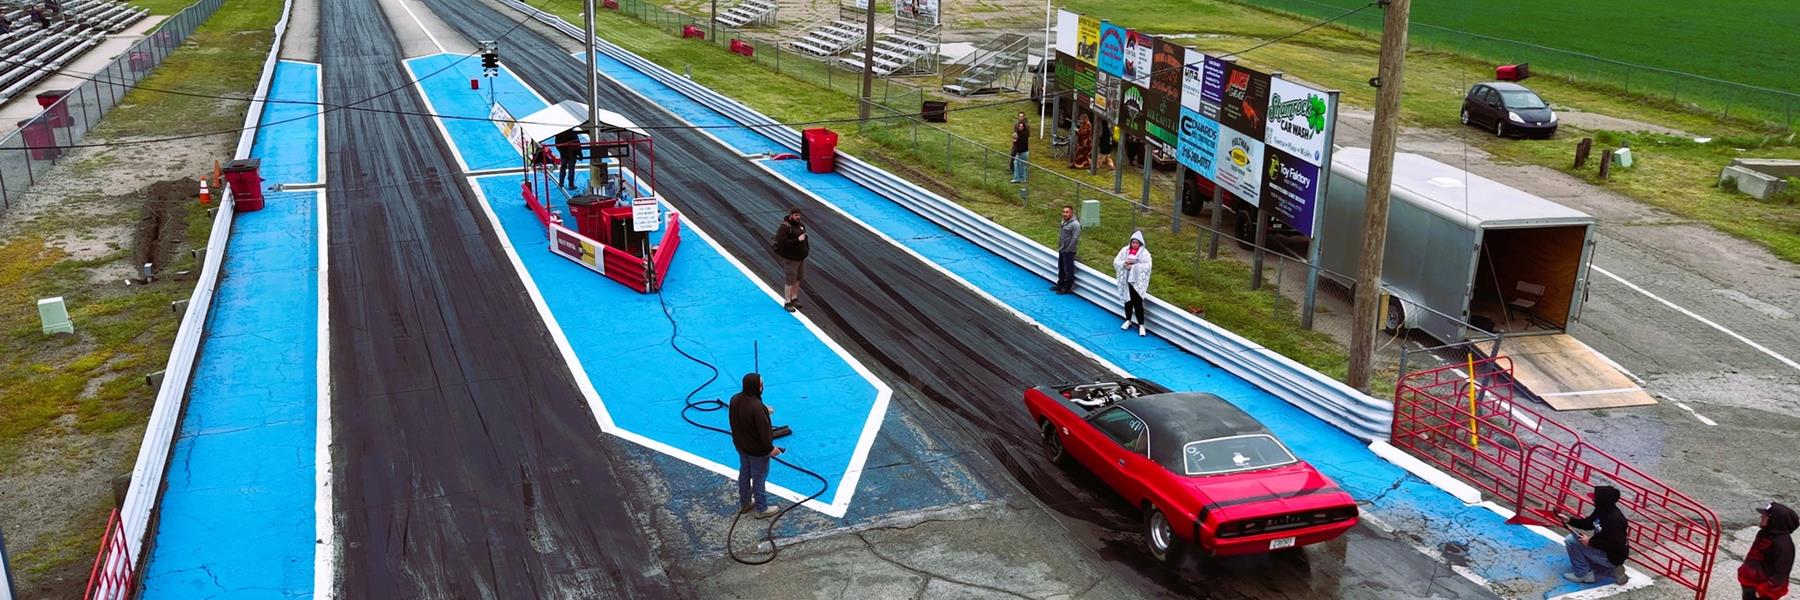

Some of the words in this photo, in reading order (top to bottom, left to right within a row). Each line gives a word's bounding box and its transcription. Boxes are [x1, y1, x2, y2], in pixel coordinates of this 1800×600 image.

[1268, 93, 1312, 123] Shamrock
[1181, 115, 1217, 140] EDWARDS
[1281, 119, 1292, 134] CAR
[1292, 123, 1310, 140] WASH
[1280, 163, 1290, 178] Toy
